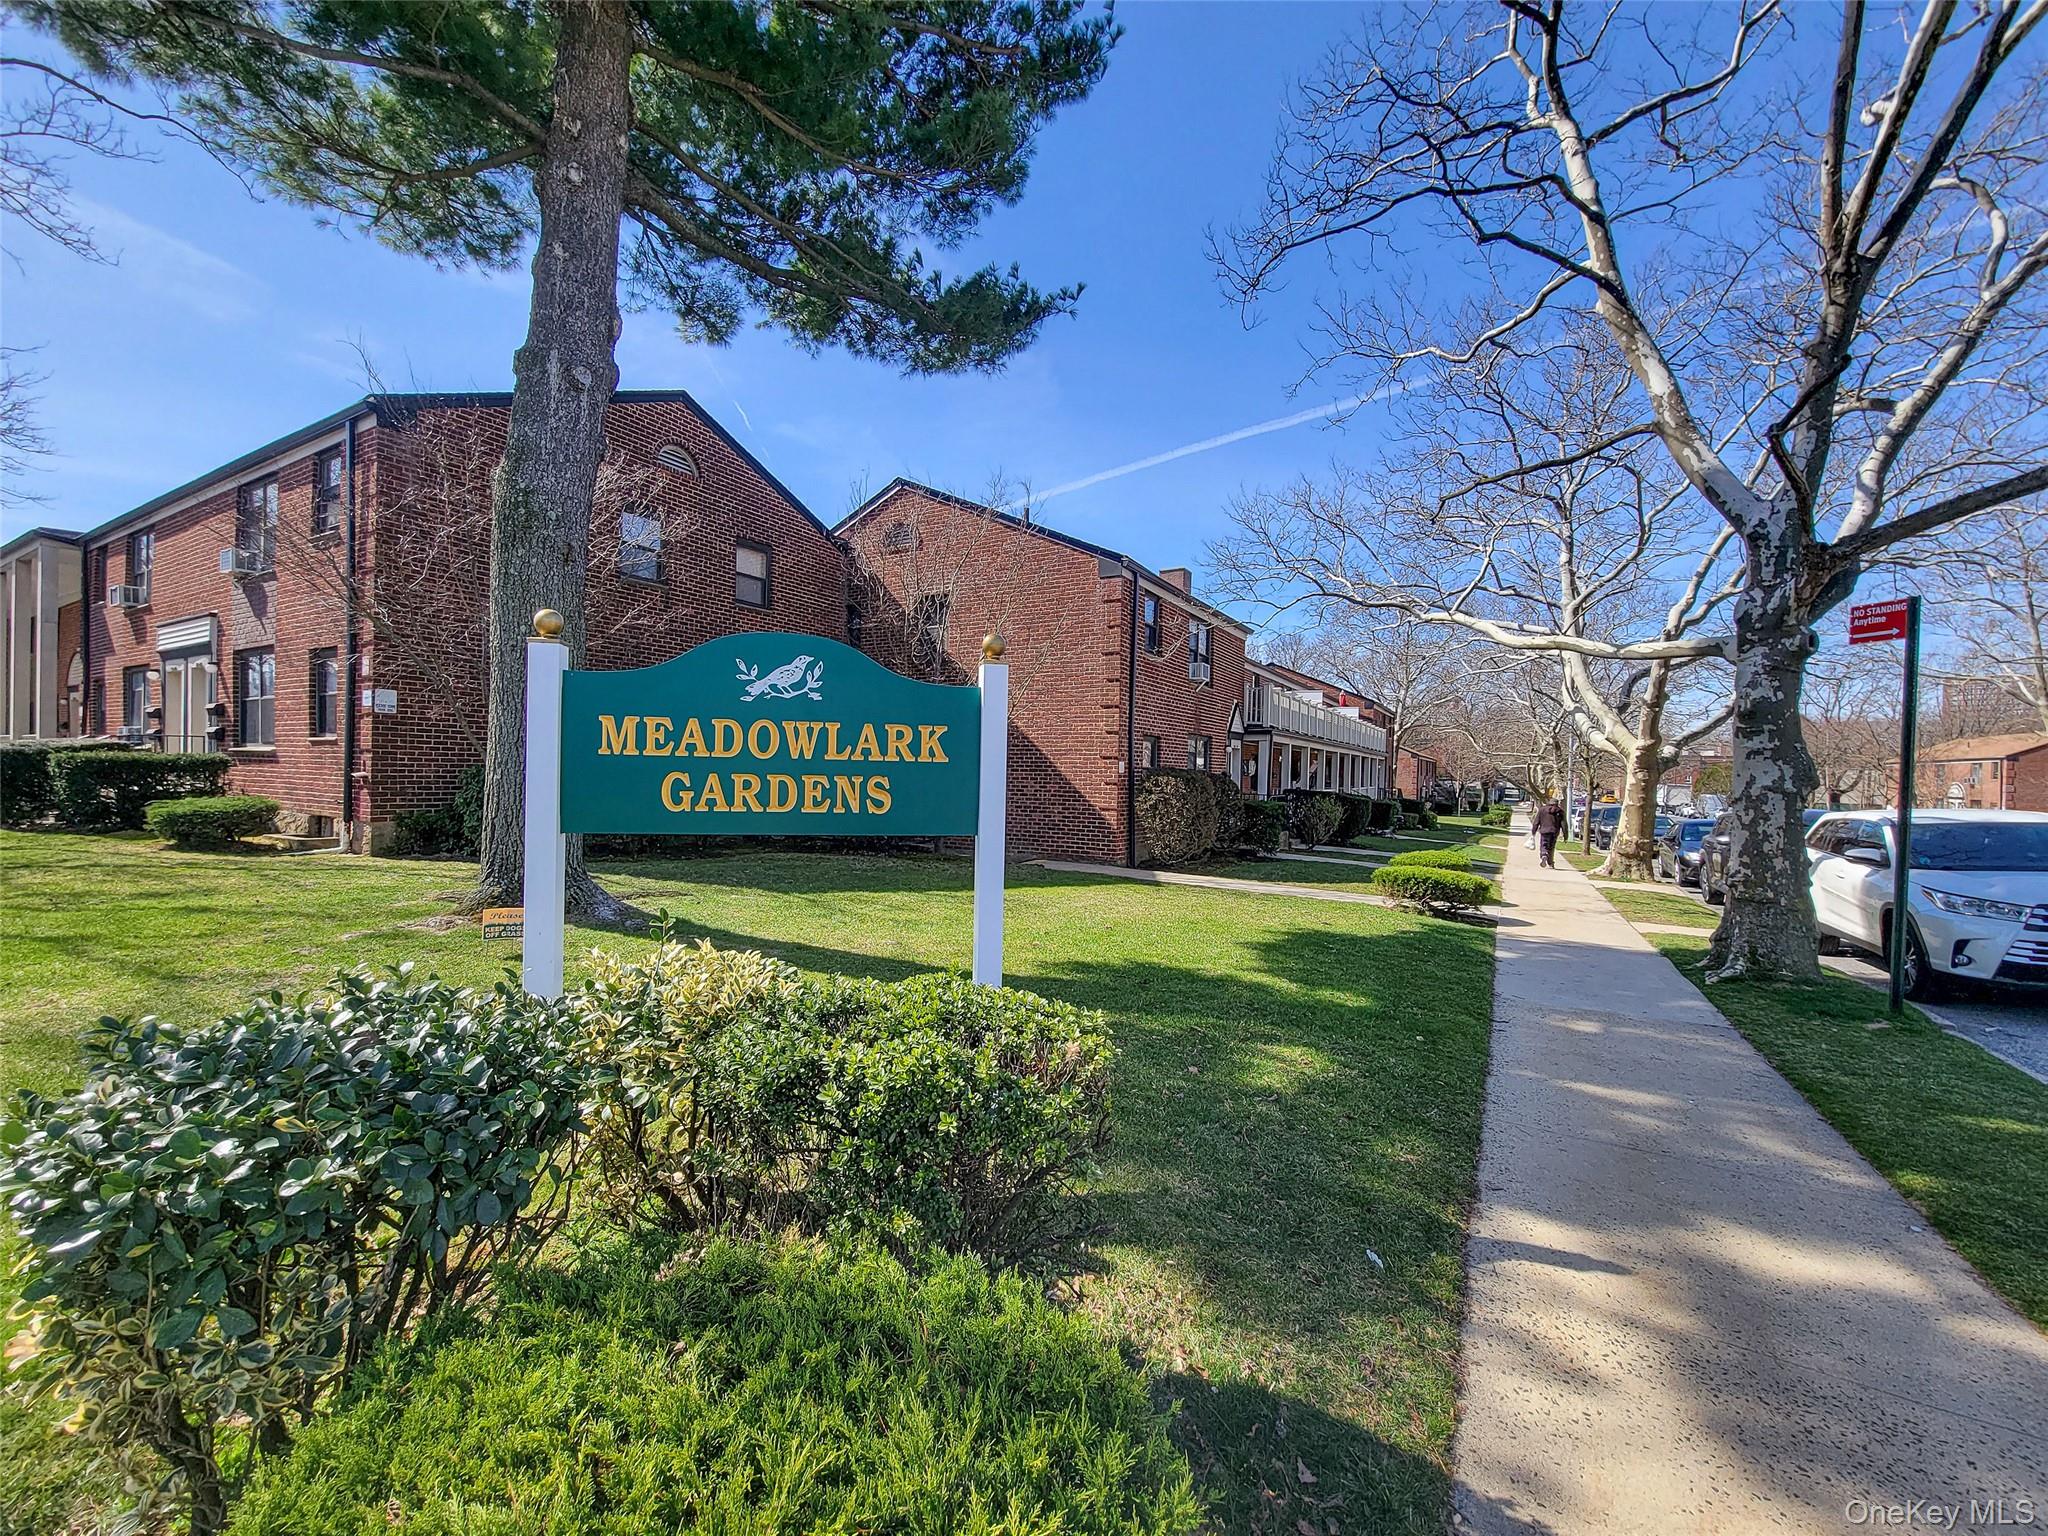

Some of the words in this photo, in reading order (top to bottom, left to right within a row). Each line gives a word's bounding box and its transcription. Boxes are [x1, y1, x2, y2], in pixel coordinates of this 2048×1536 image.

[1854, 616, 1886, 626] Anytime
[1866, 603, 1907, 615] STANDING
[598, 715, 949, 763] MEADOWLARK
[660, 771, 892, 815] GARDENS
